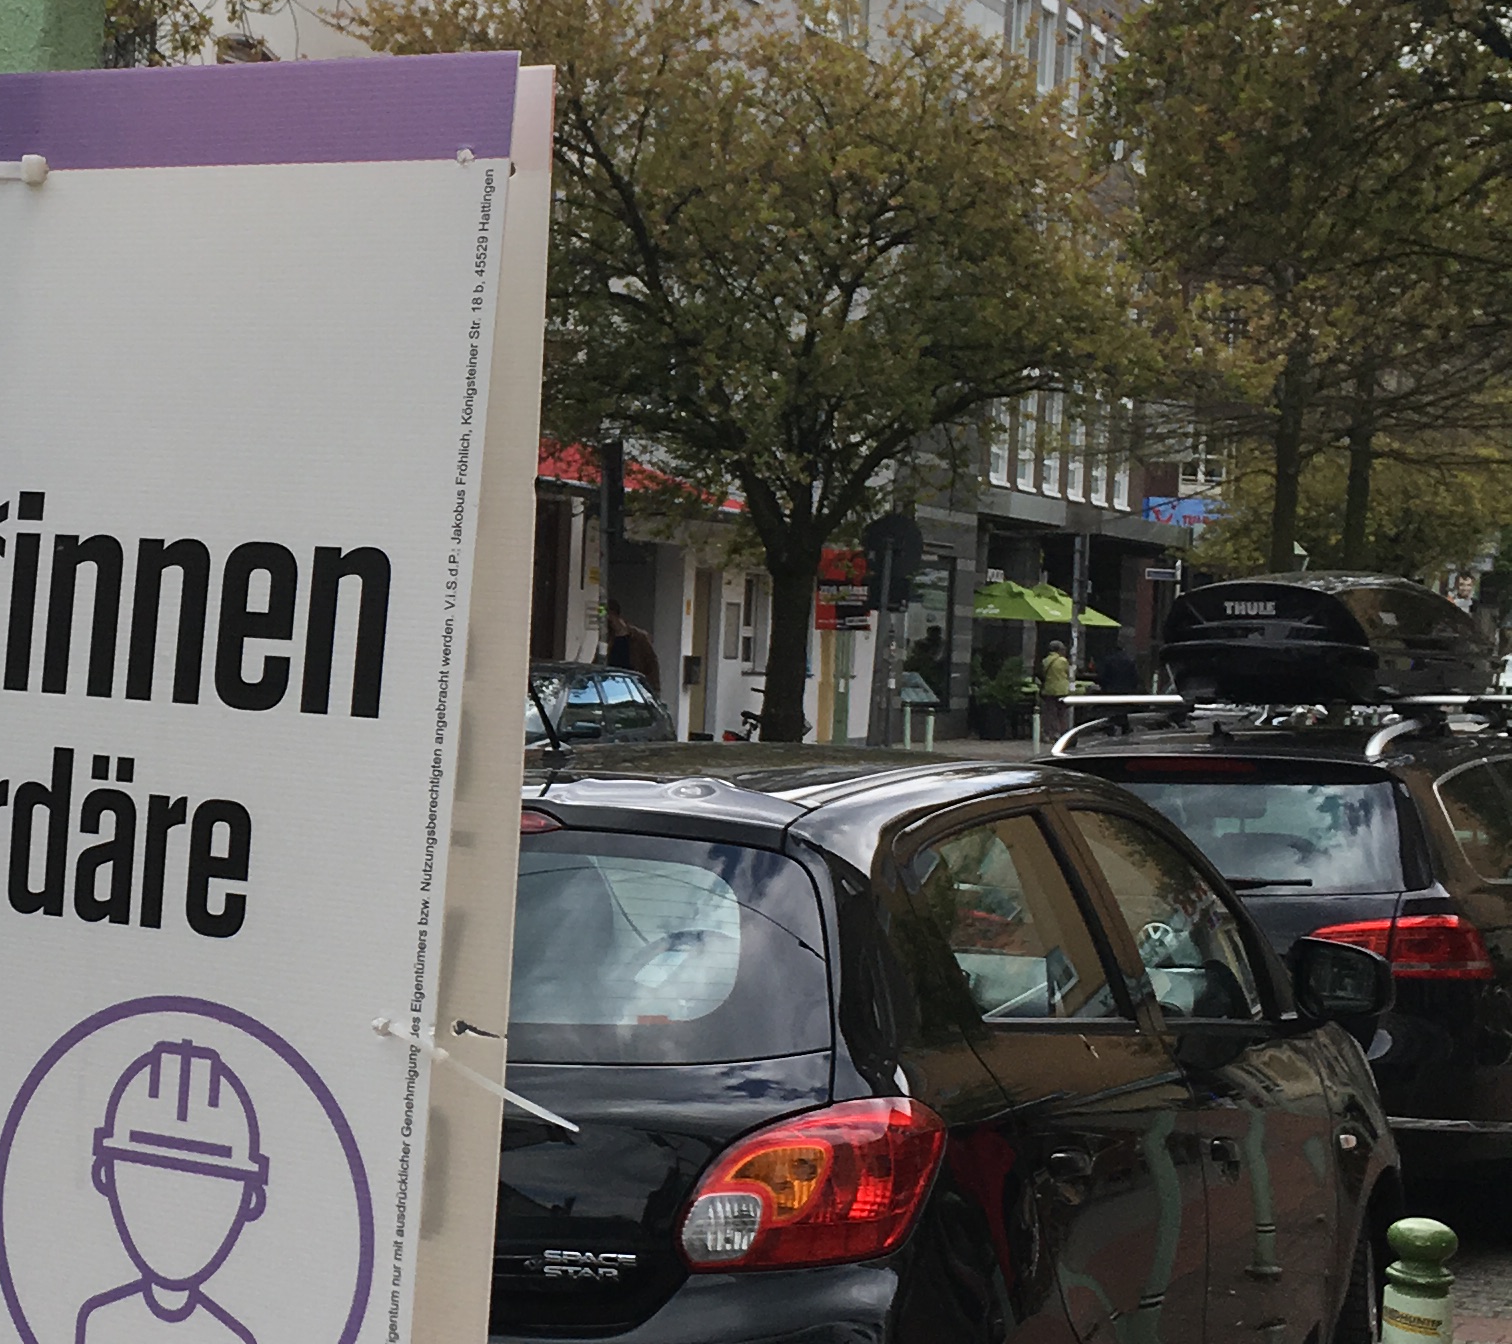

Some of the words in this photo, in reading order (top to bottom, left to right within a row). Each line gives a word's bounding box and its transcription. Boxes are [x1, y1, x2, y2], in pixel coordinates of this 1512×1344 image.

[477, 168, 495, 231] Hattingen
[474, 235, 488, 276] 45529
[468, 318, 481, 339] Str.
[460, 342, 478, 424] Königsteiner
[454, 429, 472, 485] Fröhlich,
[450, 489, 465, 544] Jakobus
[1224, 601, 1276, 615] THULE
[440, 615, 454, 666] werden.
[432, 670, 449, 744] angebracht
[419, 748, 441, 891] Nutzungsberechtigten
[416, 896, 430, 926] bzw.
[409, 929, 427, 1012] Eigentümers
[394, 1140, 411, 1238] ausdrücklicher
[390, 1263, 401, 1286] nur
[392, 1239, 403, 1262] mit
[543, 1249, 636, 1267] SPACE
[543, 1265, 619, 1281] STAR
